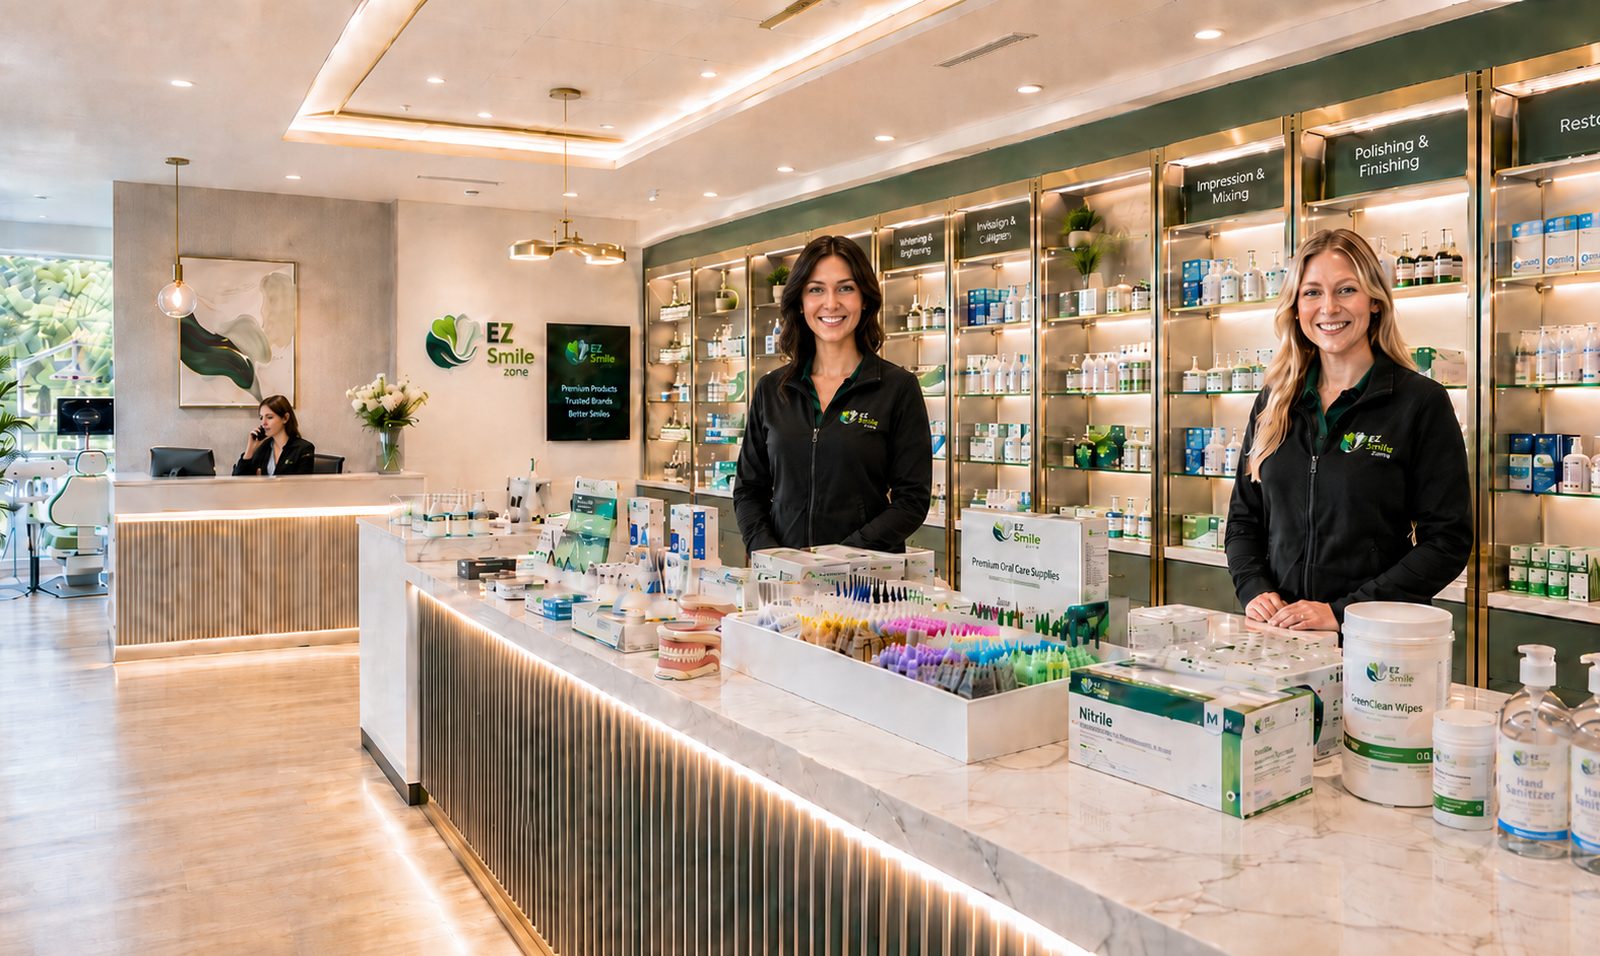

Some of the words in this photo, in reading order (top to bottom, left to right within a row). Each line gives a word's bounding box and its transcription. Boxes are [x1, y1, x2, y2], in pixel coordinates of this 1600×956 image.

[1355, 140, 1414, 160] Polishing
[1418, 134, 1429, 148] &
[1360, 157, 1419, 178] Finishing
[1197, 172, 1254, 192] Impression
[1256, 167, 1265, 180] &
[1212, 189, 1249, 204] Mixing
[1010, 215, 1016, 226] &
[486, 321, 514, 344] EZ
[590, 343, 603, 353] EZ
[487, 347, 535, 364] Smile
[590, 353, 616, 363] Smile
[503, 368, 529, 377] zone
[561, 384, 590, 393] Premium
[591, 384, 618, 393] Products
[565, 396, 590, 405] Trusted
[591, 396, 613, 405] Brands
[568, 409, 588, 418] Better
[1014, 523, 1024, 532] EZ
[1013, 532, 1041, 545] Smile
[971, 556, 1000, 570] Premium
[1000, 561, 1014, 573] Oral
[1014, 564, 1031, 576] Care
[1030, 566, 1060, 581] Supplies
[1389, 666, 1400, 674] EZ
[1388, 674, 1415, 683] Smile
[1394, 702, 1424, 714] Wipes
[1079, 706, 1113, 728] Nitrile
[1206, 711, 1219, 726] M
[1516, 776, 1544, 789] Hand
[1505, 783, 1556, 801] Sanitizer
[1584, 786, 1600, 799] Ha
